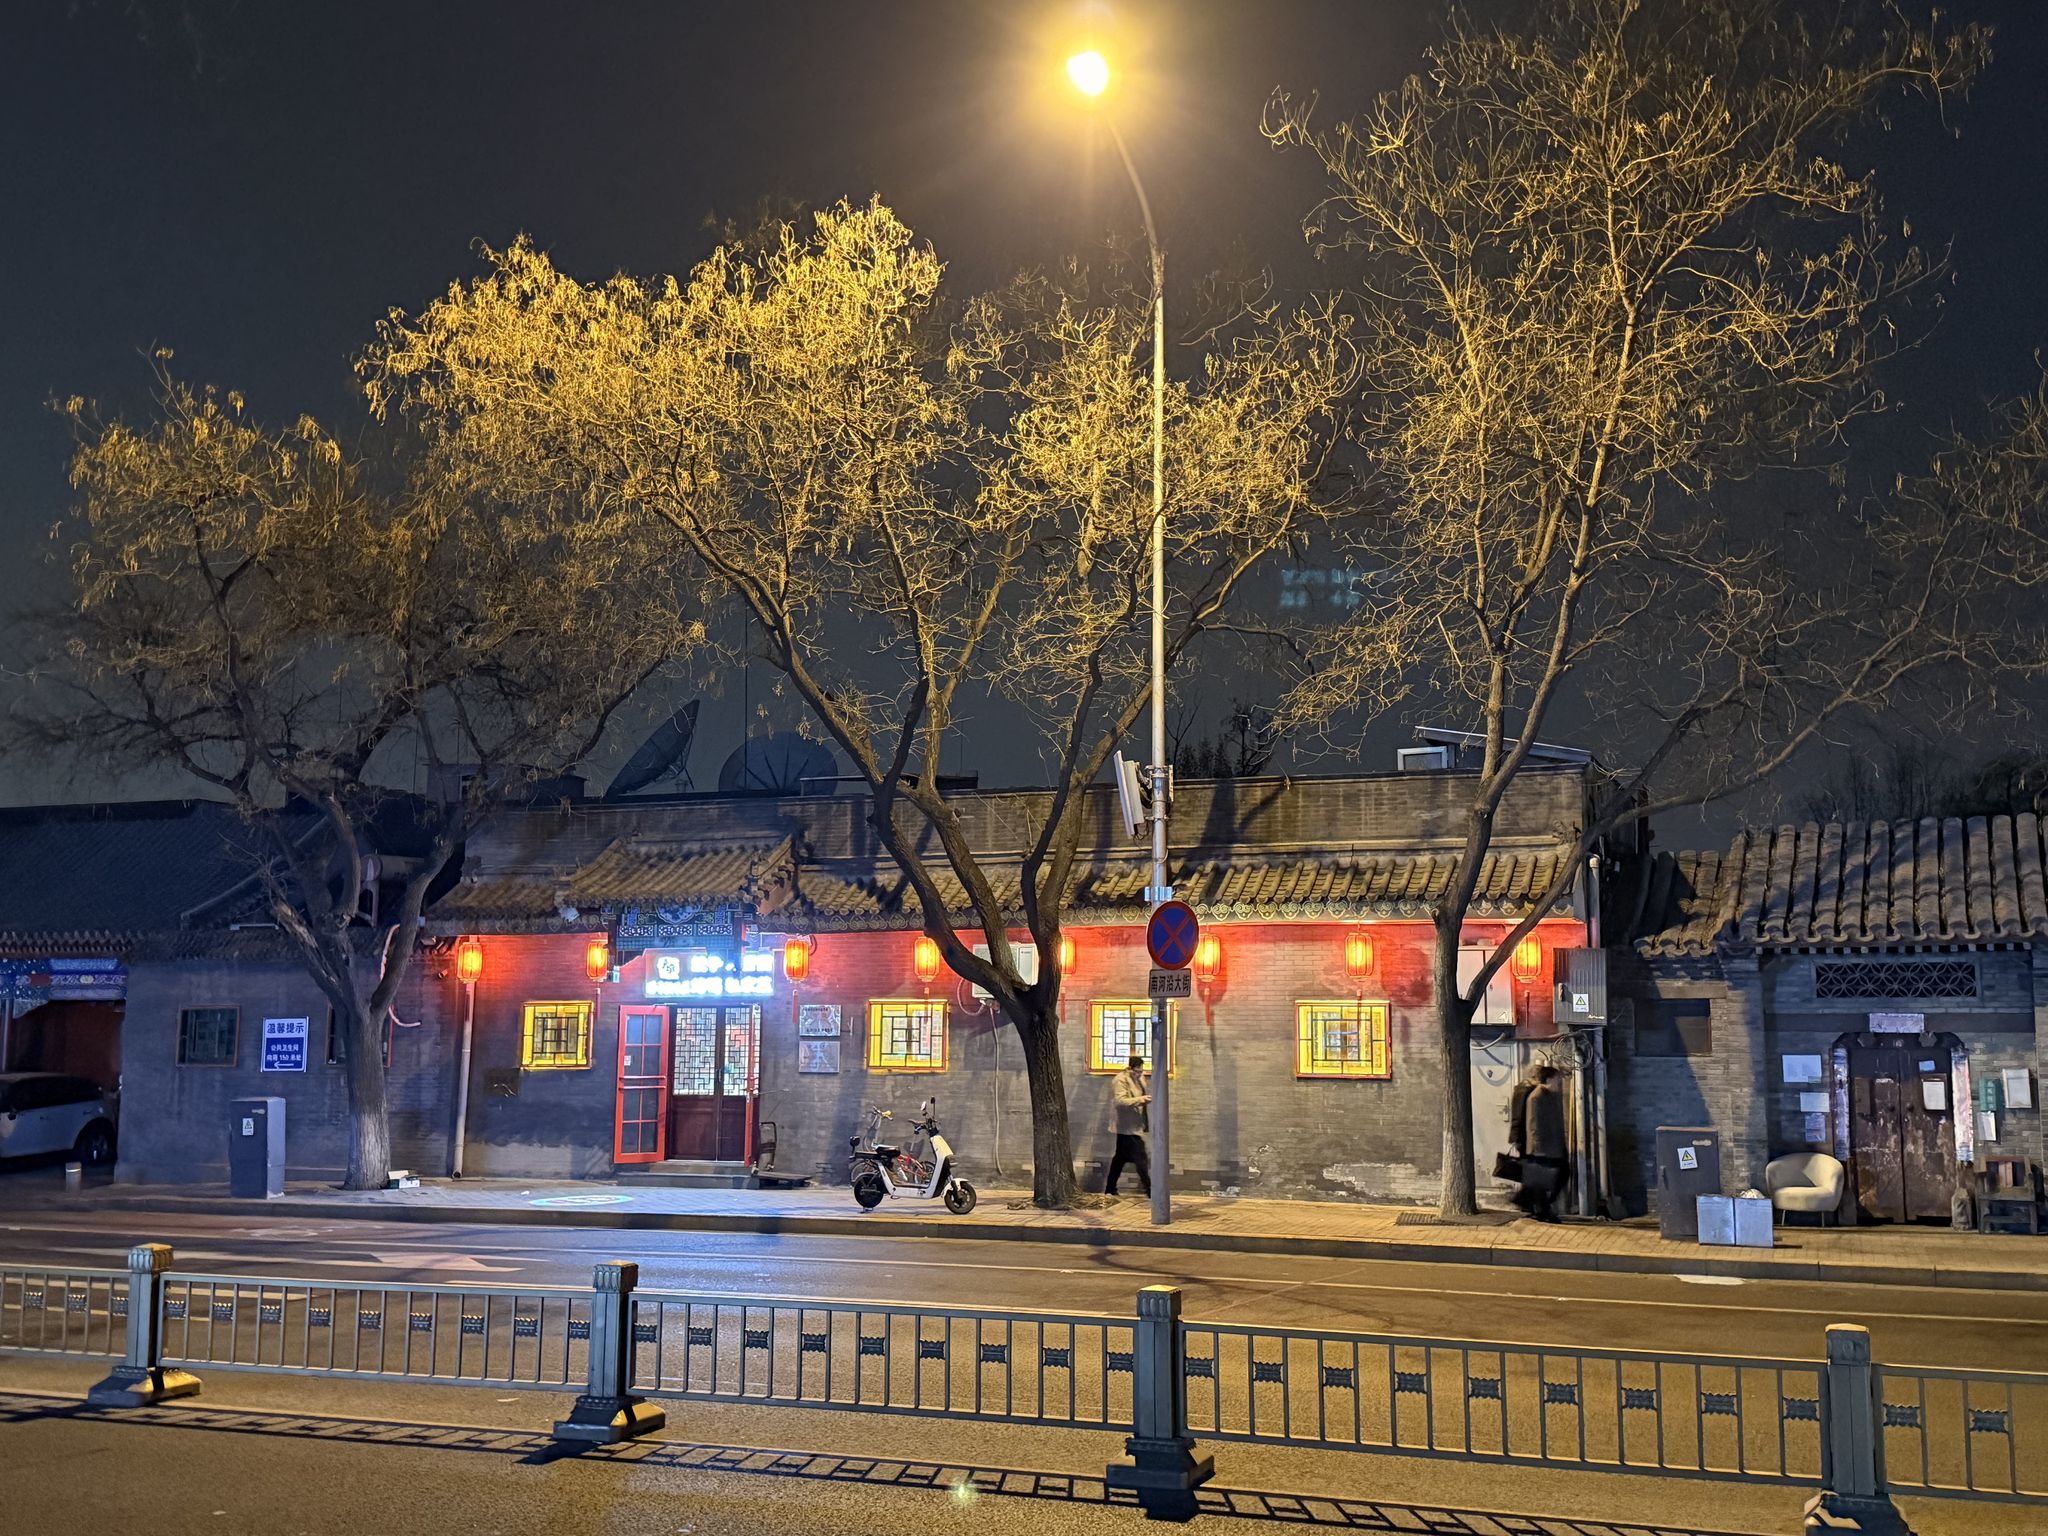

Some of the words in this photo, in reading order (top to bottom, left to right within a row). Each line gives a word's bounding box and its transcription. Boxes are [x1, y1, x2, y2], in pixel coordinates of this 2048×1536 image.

[1151, 974, 1190, 993] 南河沿大街
[267, 1022, 304, 1034] 温馨提示
